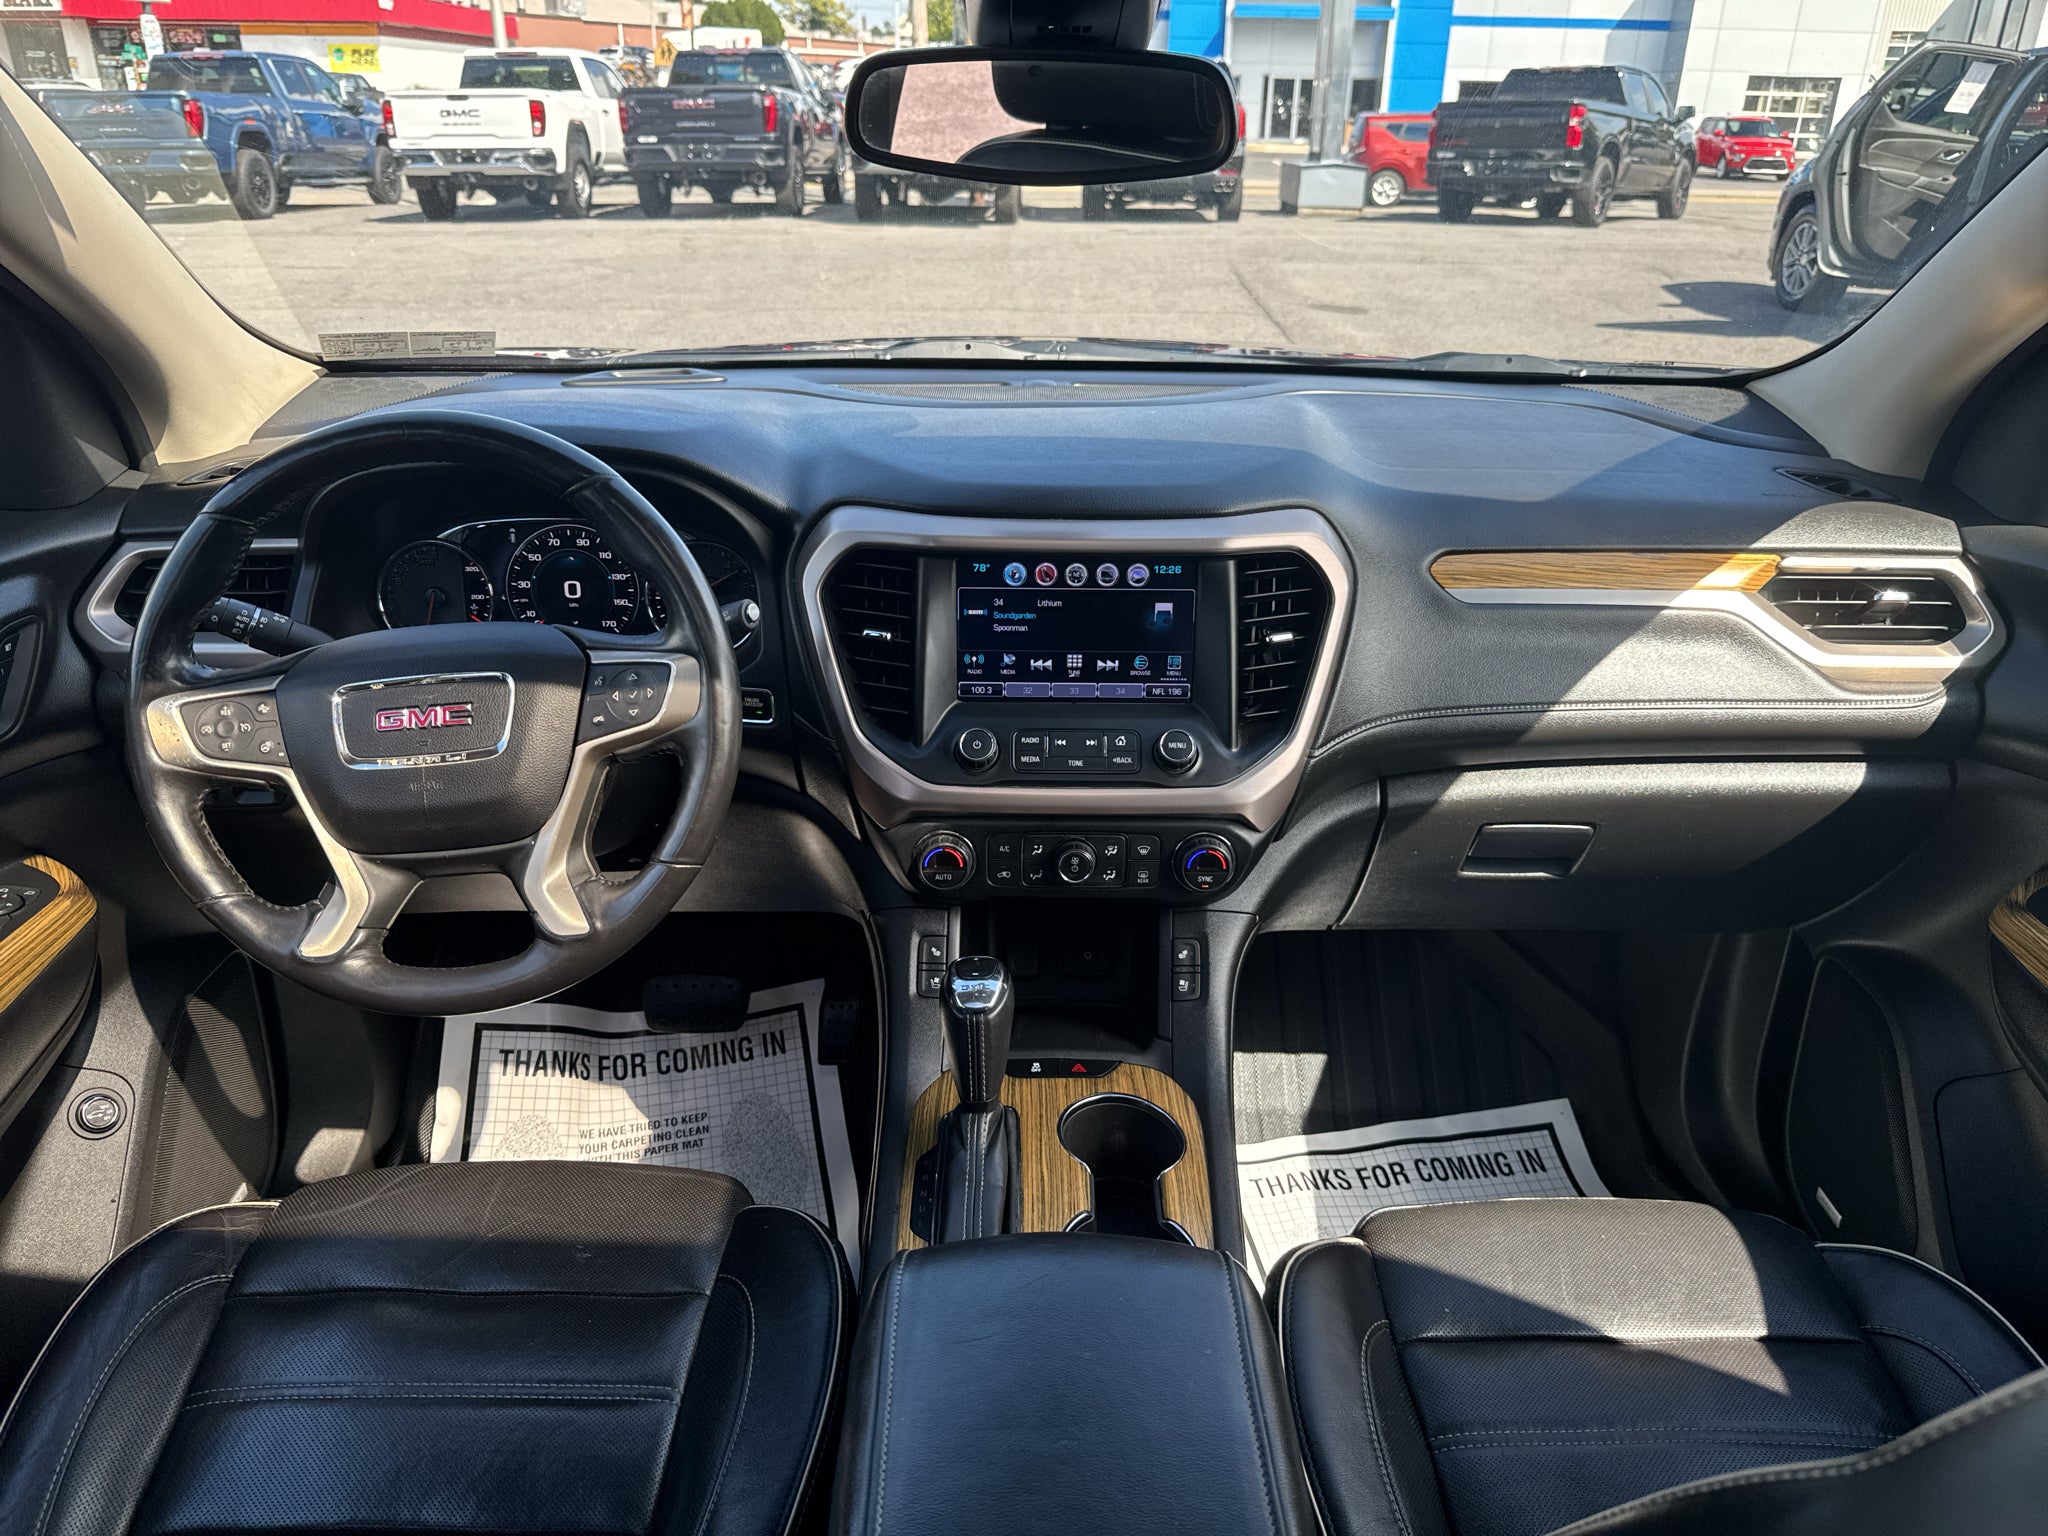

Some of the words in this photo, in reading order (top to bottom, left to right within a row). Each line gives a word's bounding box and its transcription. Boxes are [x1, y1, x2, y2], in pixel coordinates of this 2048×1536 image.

[440, 109, 481, 118] GMC
[599, 551, 612, 559] 110
[1154, 565, 1182, 574] 12:26
[563, 580, 582, 599] 0
[1037, 599, 1062, 607] Lithium
[993, 612, 1036, 620] Soundgarden
[993, 624, 1028, 632] Spoonman
[375, 702, 472, 732] GMC
[499, 1049, 591, 1081] THANKS
[597, 1055, 647, 1081] FOR
[656, 1036, 754, 1076] COMING
[762, 1029, 787, 1058] IN
[579, 1128, 595, 1140] WE
[598, 1125, 627, 1138] HAVE
[629, 1121, 660, 1133] TRIED
[664, 1117, 678, 1127] TO
[681, 1112, 708, 1125] KEEP
[579, 1142, 608, 1154] YOUR
[612, 1130, 672, 1150] CARPETING
[675, 1125, 710, 1139] CLEAN
[616, 1150, 641, 1161] THIS
[644, 1143, 678, 1157] PAPER
[682, 1138, 705, 1150] MAT
[1249, 1168, 1352, 1199] THANKS
[1357, 1161, 1410, 1190] FOR
[1415, 1152, 1514, 1182] COMING
[1518, 1148, 1548, 1175] IN
